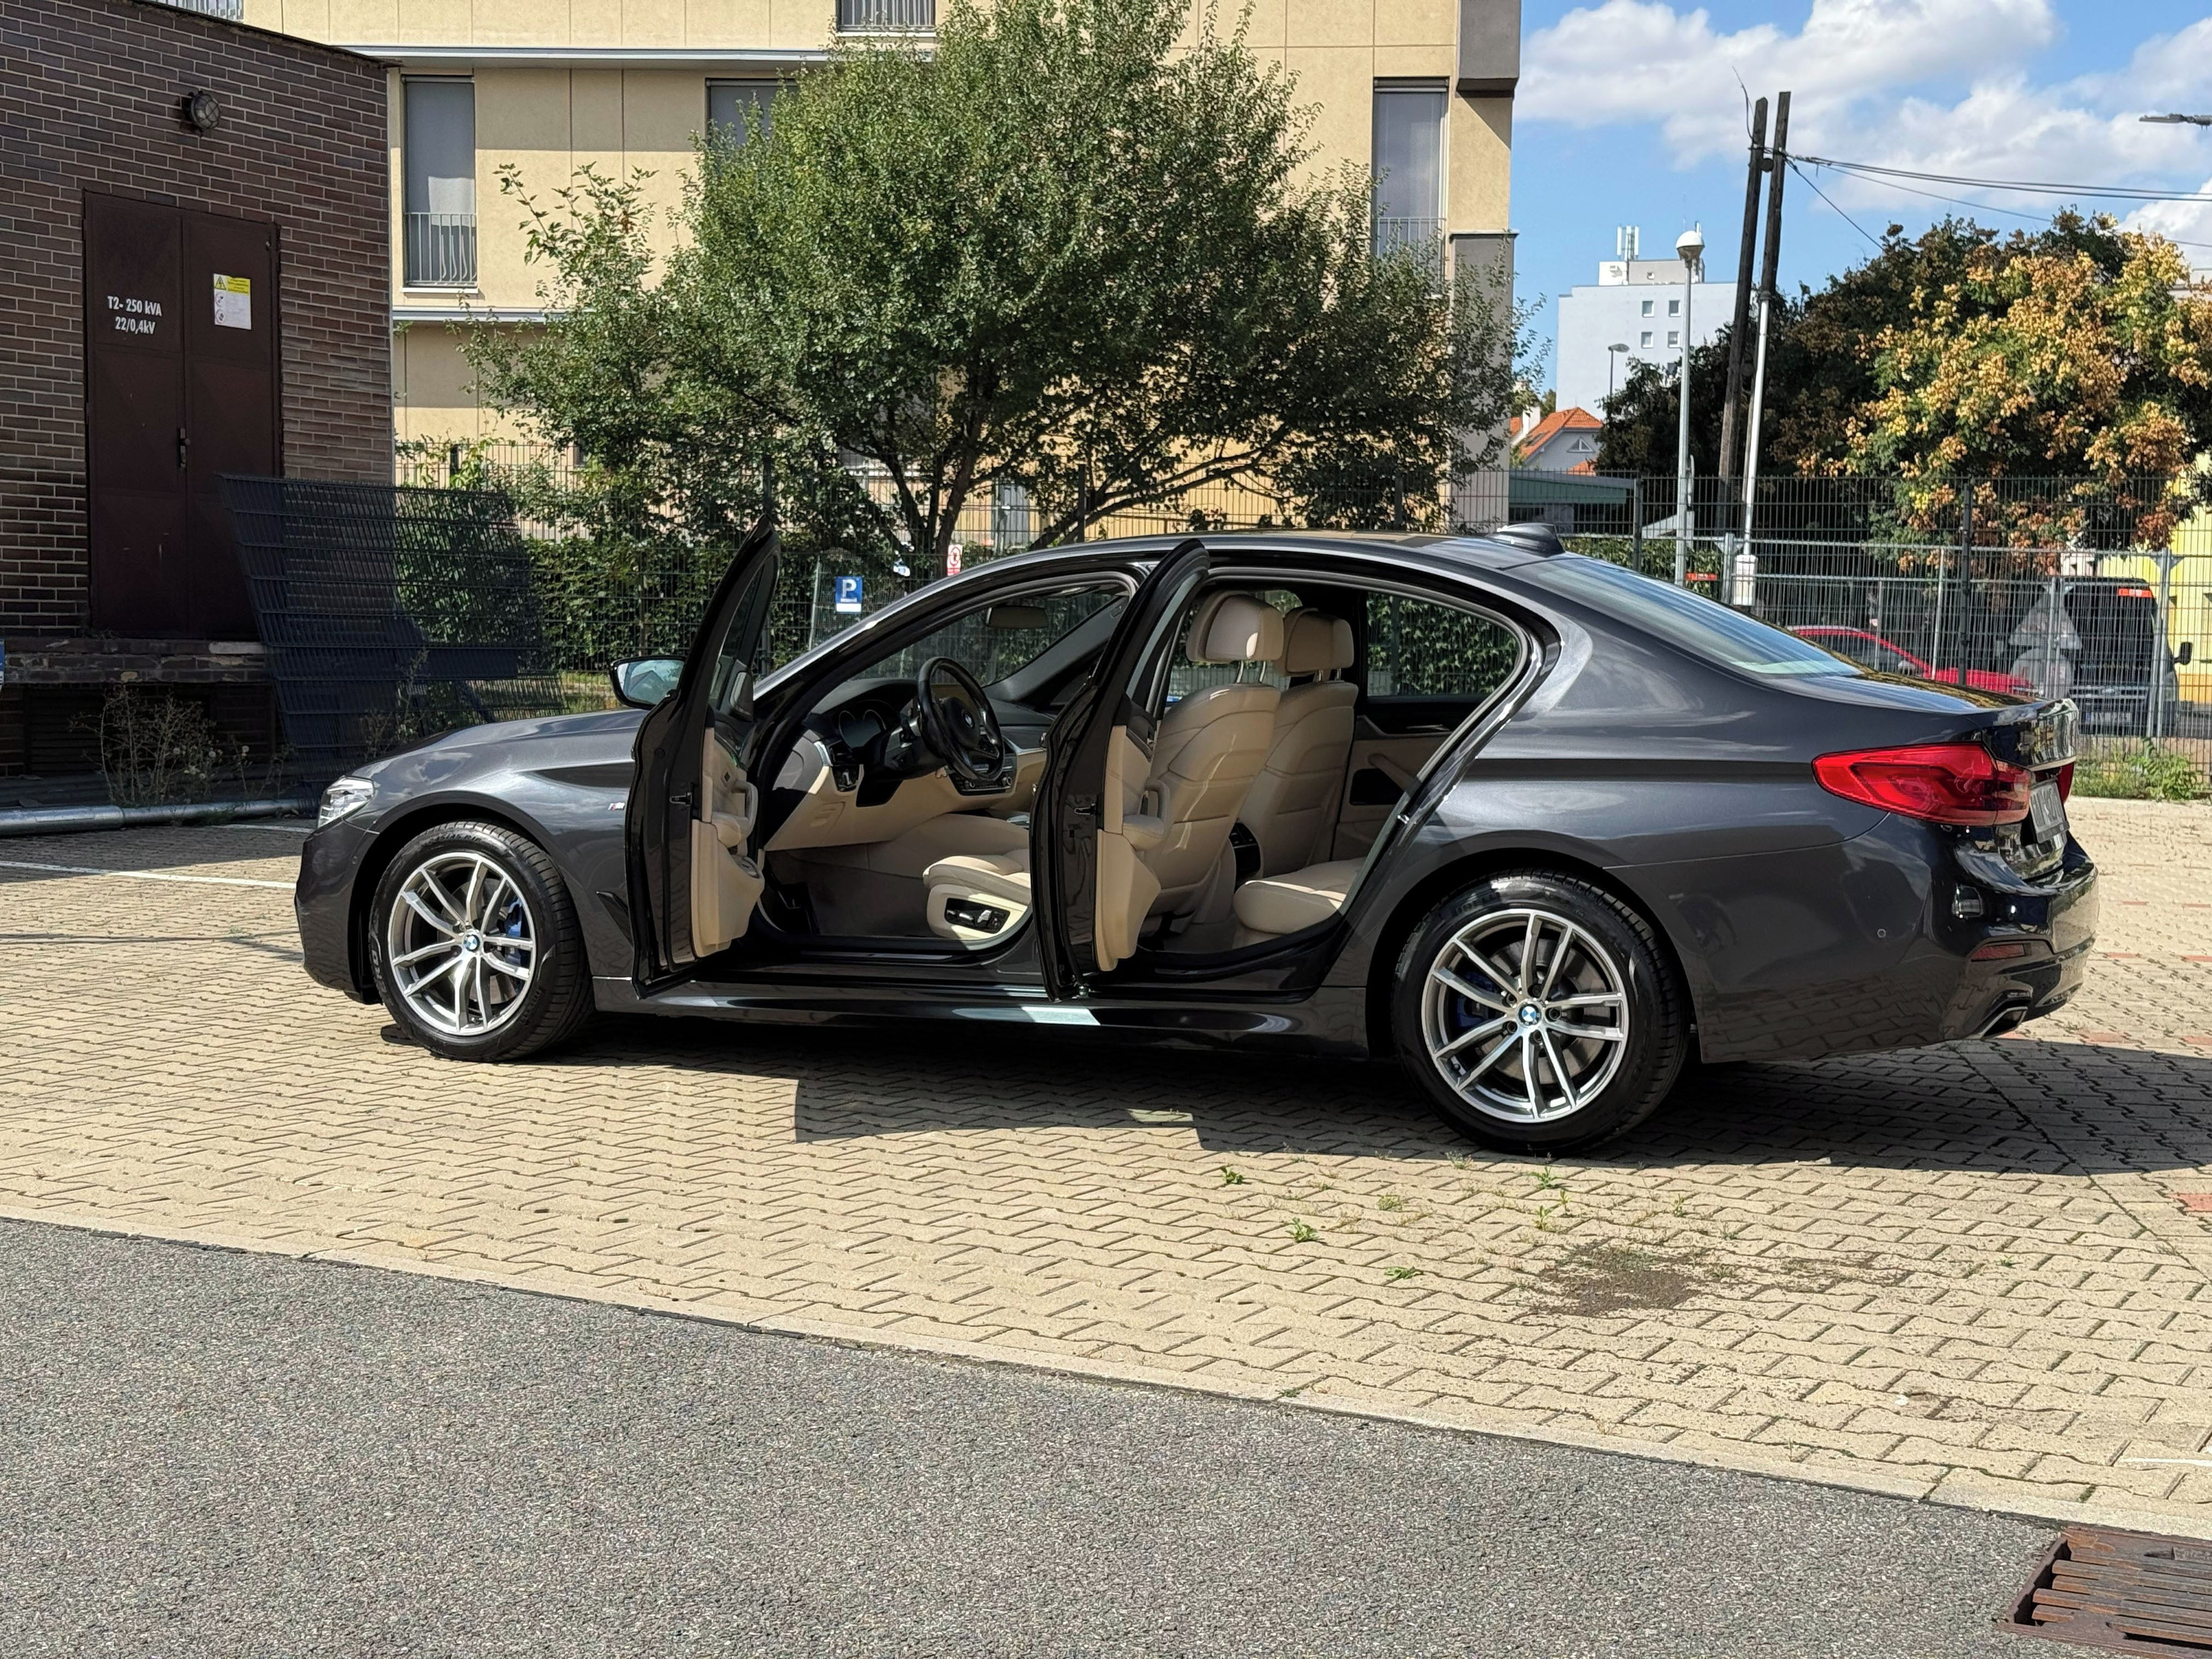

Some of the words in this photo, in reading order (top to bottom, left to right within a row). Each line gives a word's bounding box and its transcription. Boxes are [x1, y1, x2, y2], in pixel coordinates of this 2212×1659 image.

[126, 298, 143, 313] 250
[145, 300, 162, 317] kVA
[115, 316, 156, 335] 22/0,4kV
[842, 579, 856, 597] P
